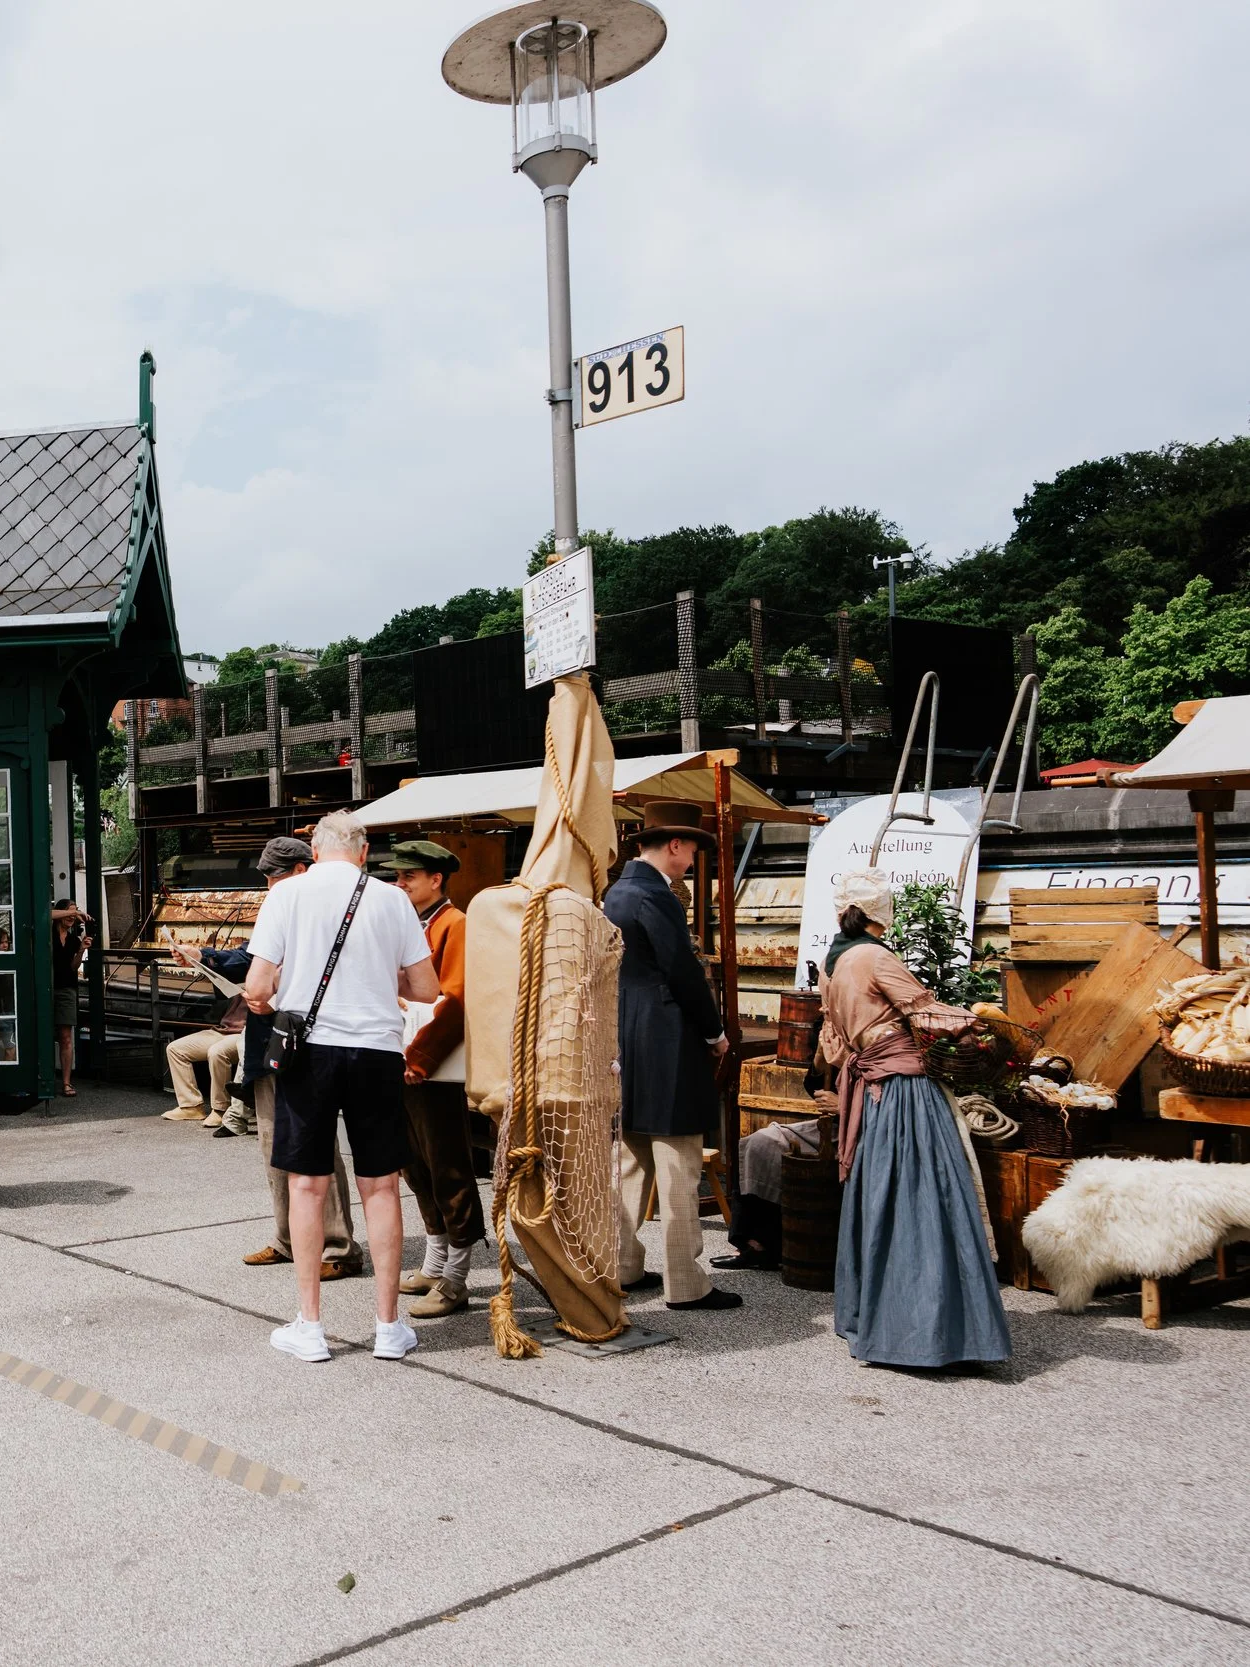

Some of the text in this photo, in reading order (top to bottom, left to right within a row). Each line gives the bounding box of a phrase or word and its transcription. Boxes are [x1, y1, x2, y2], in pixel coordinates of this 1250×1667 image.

[588, 342, 670, 413] 913
[539, 563, 567, 592] VORSICHT
[336, 890, 362, 944] TOMMY HILFIGER
[313, 951, 338, 1007] TOMMY HILFIGER
